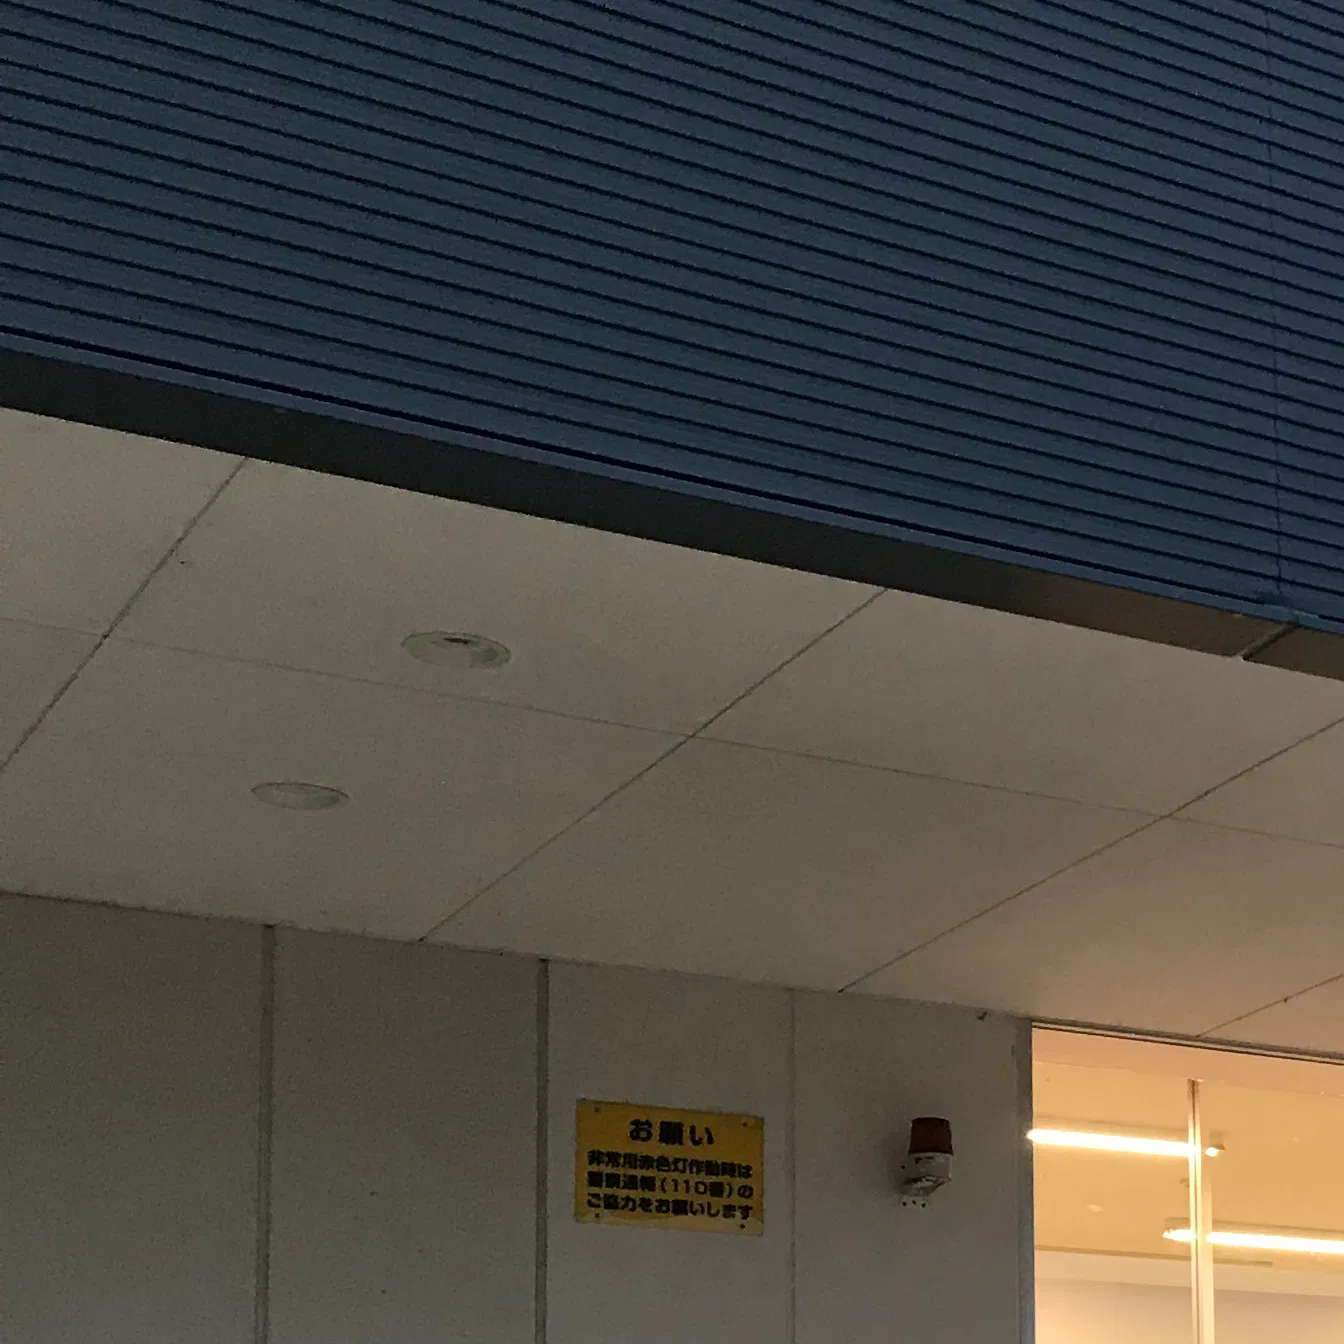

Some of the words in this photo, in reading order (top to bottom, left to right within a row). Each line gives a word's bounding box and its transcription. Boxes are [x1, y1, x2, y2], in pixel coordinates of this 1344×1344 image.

[628, 1118, 715, 1147] お願い
[587, 1192, 753, 1220] ご協力をお願いします
